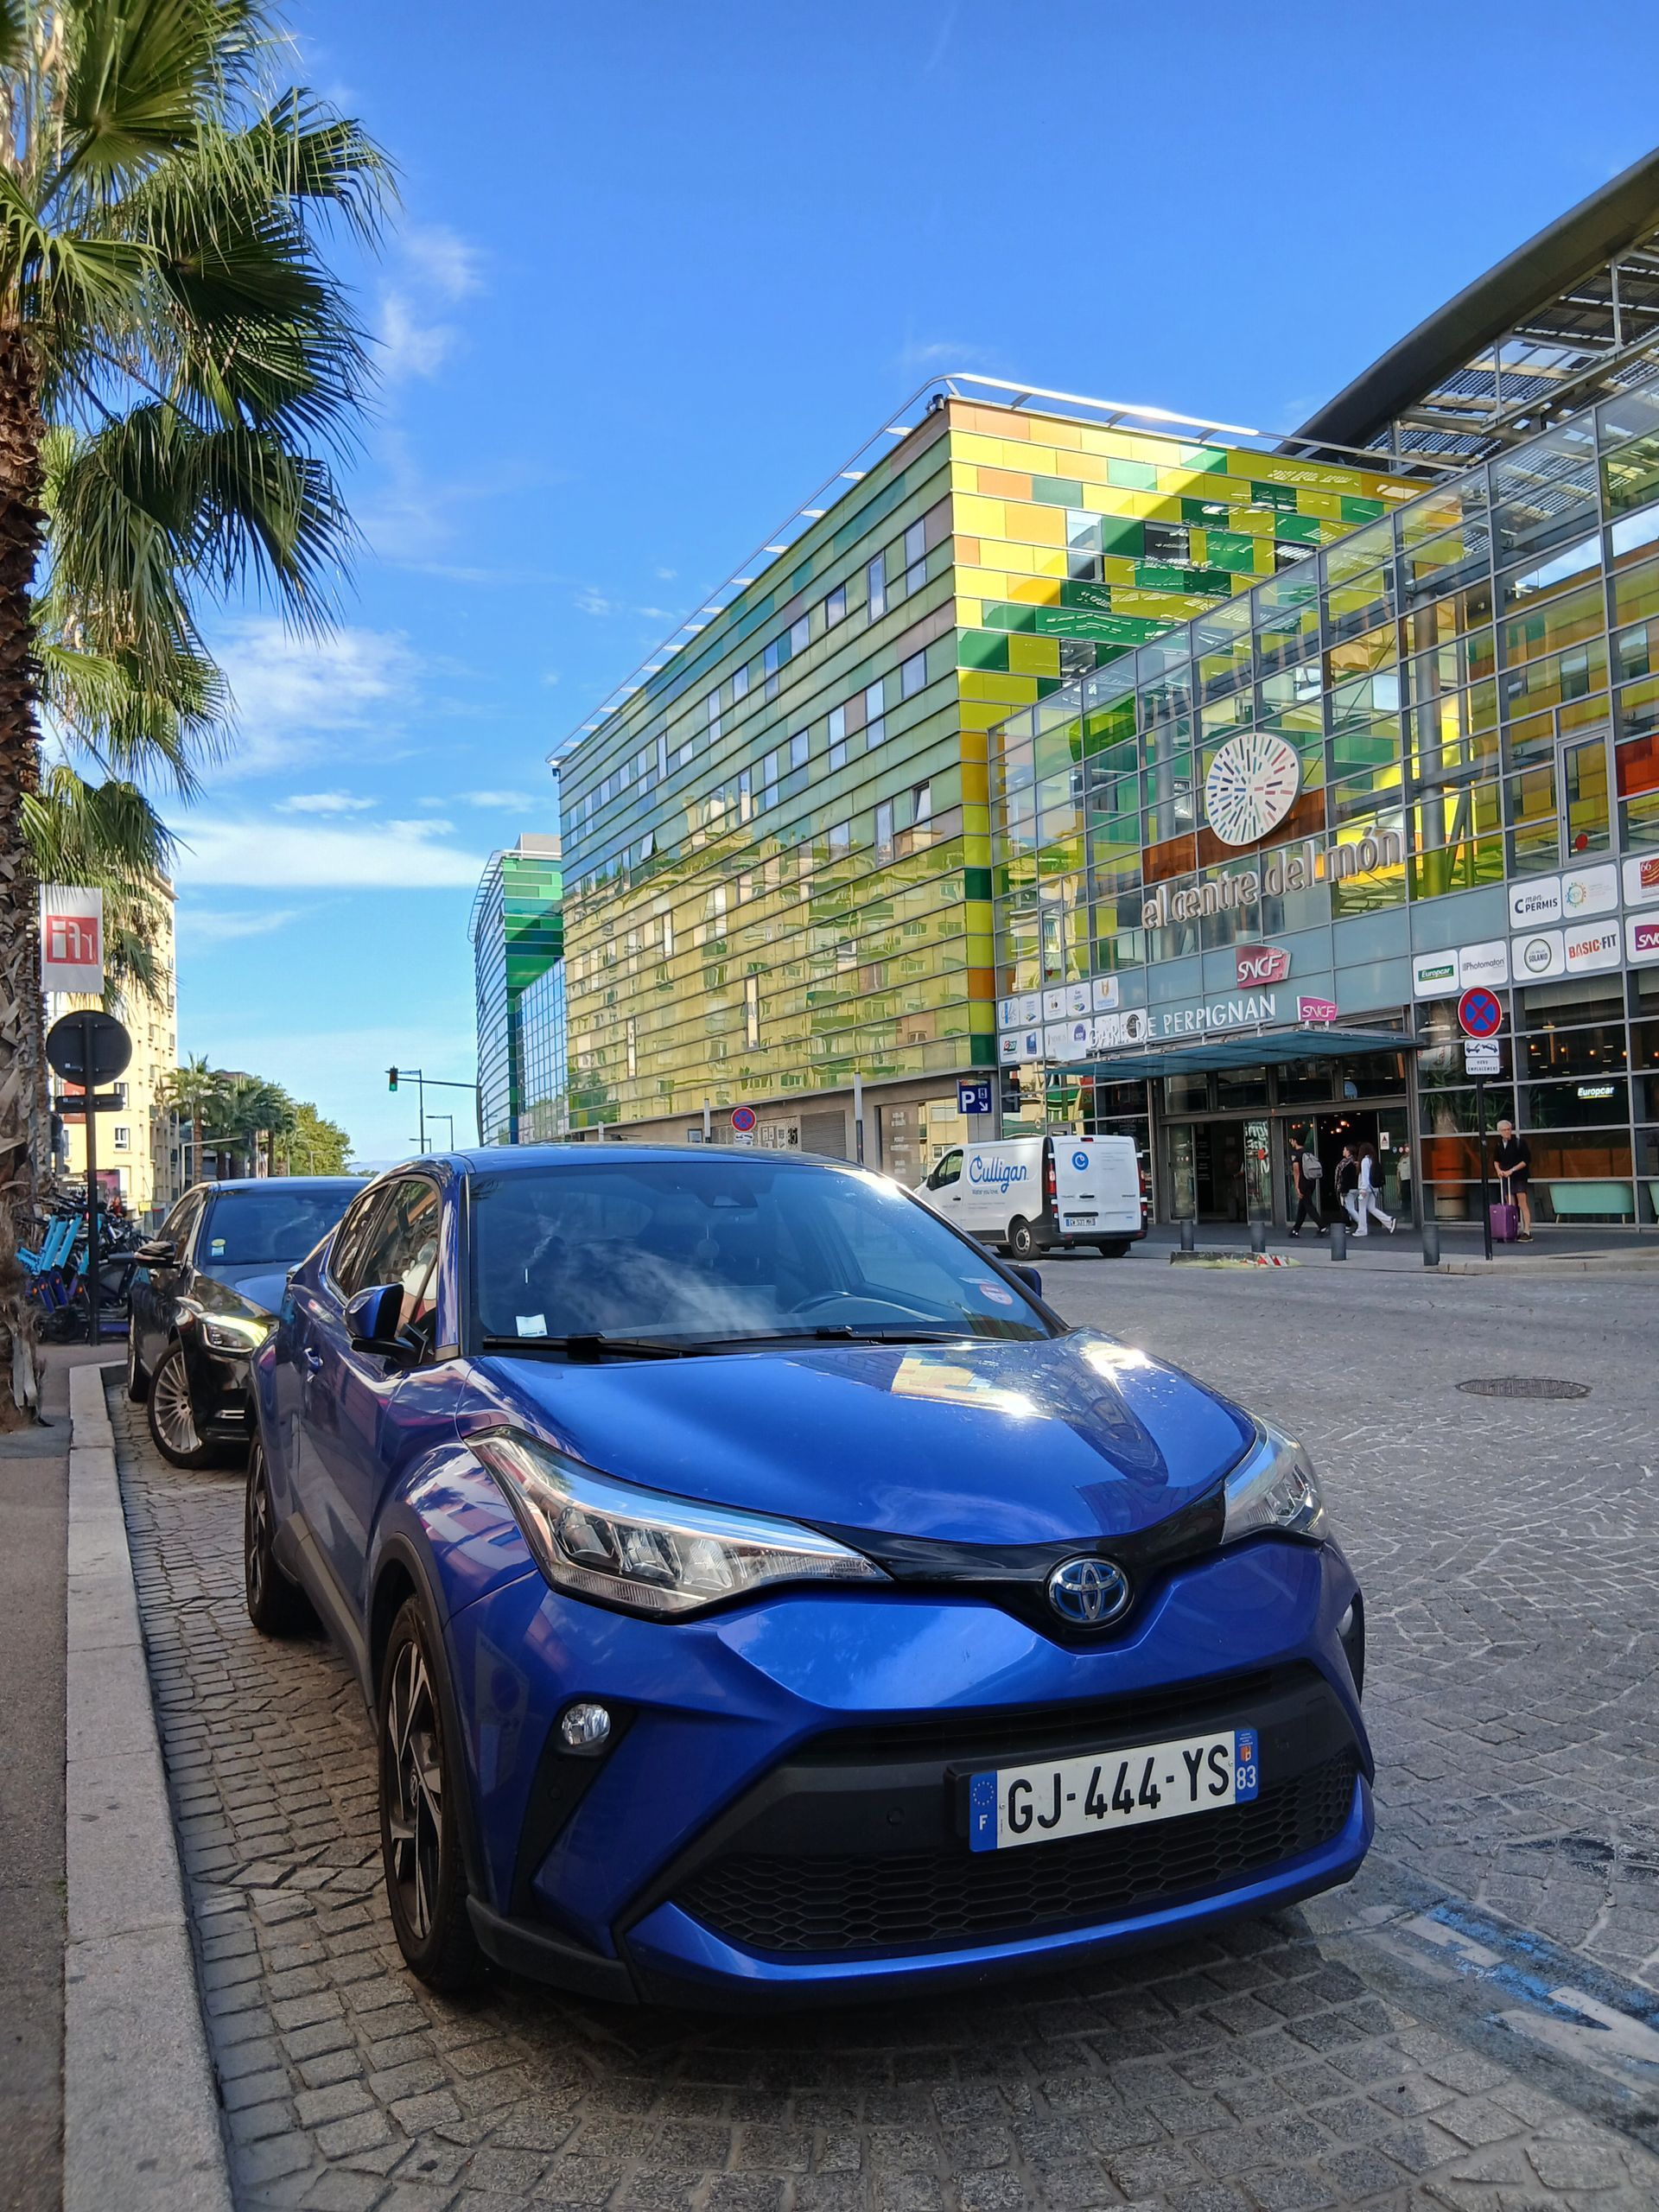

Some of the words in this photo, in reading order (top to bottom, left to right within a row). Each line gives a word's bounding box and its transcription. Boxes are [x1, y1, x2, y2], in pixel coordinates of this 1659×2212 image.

[1141, 884, 1167, 930] el
[1172, 870, 1258, 925] centre
[1265, 839, 1315, 897] del
[1325, 825, 1406, 884] món
[1525, 898, 1558, 912] PERMIS
[1637, 931, 1659, 950] SNC
[1237, 953, 1282, 982] SNCF
[1421, 967, 1452, 979] Europcar
[1465, 957, 1505, 972] Photomaton
[1135, 1016, 1157, 1039] DE
[1164, 994, 1276, 1035] PERPIGNAN
[1302, 1005, 1336, 1018] SNCF
[961, 1090, 976, 1112] P
[1577, 1086, 1615, 1098] Europcar
[969, 1154, 1027, 1194] Culligan
[1236, 1765, 1256, 1790] 83
[1007, 1745, 1230, 1834] GJ-444-YS
[979, 1815, 988, 1830] F
